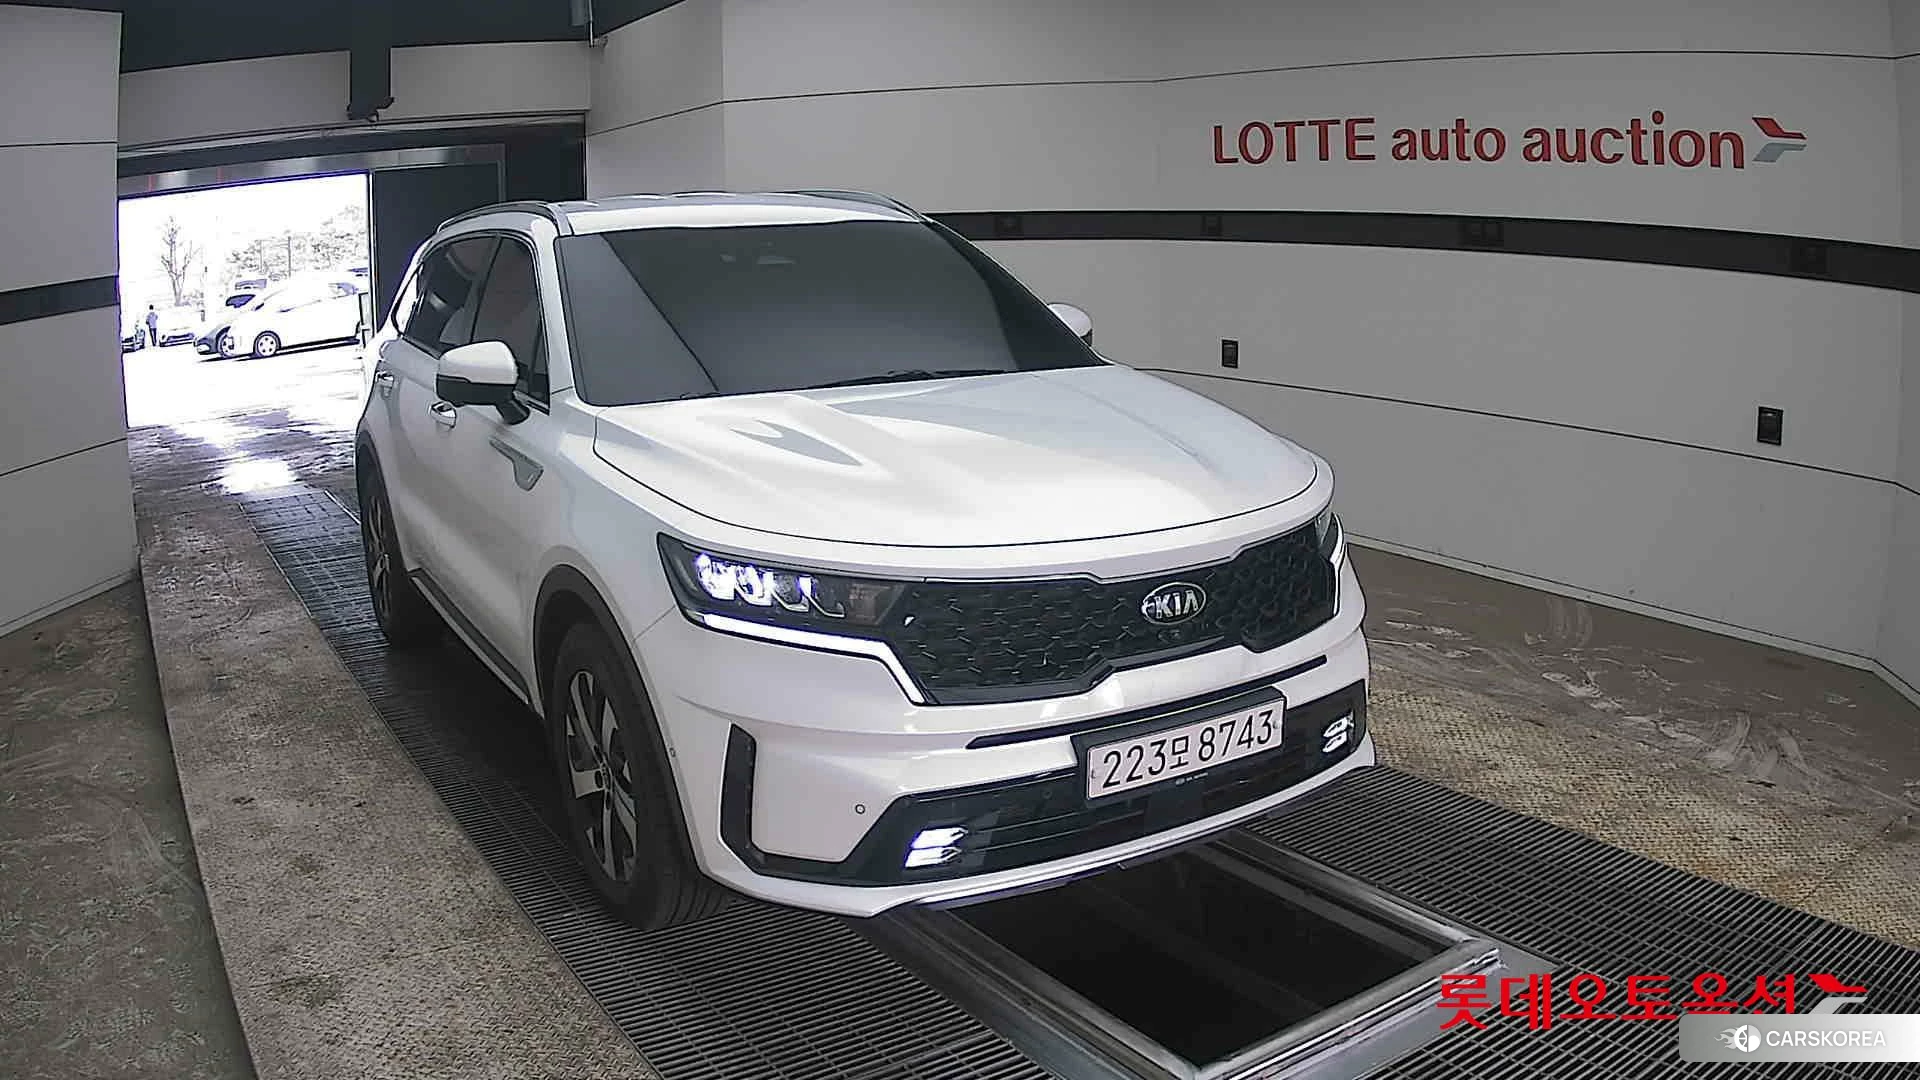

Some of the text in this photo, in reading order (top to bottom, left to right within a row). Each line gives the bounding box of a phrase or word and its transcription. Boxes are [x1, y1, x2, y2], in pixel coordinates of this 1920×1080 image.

[1213, 111, 1745, 169] LOTTE auto auction
[1153, 589, 1200, 619] KIA
[1102, 709, 1274, 788] 223모 8743
